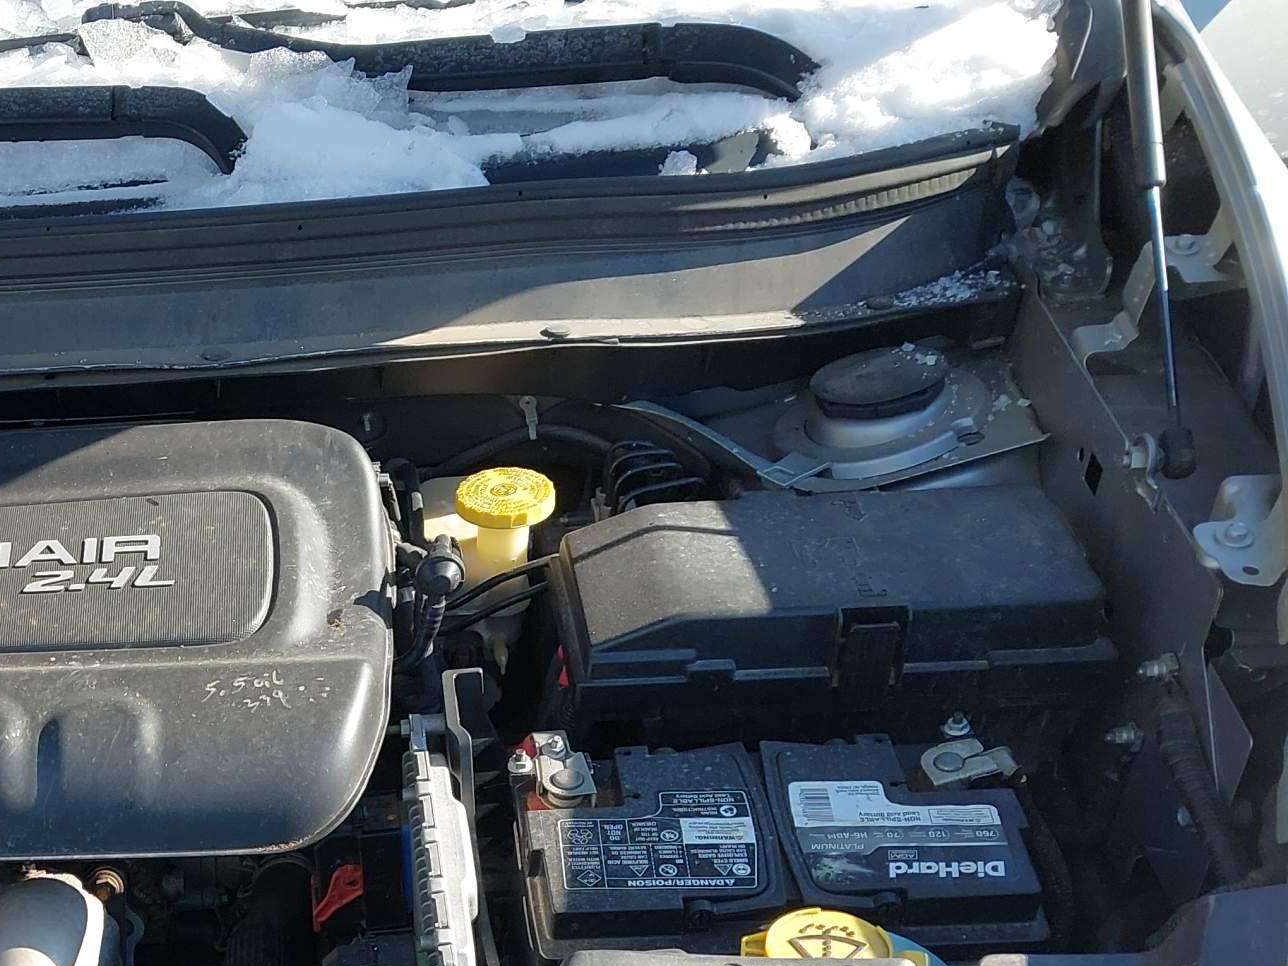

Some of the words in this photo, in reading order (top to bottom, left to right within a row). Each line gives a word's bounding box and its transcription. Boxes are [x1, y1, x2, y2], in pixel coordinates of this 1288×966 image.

[21, 565, 177, 594] 2.4L
[975, 830, 996, 838] 760
[889, 861, 1006, 878] DieHard
